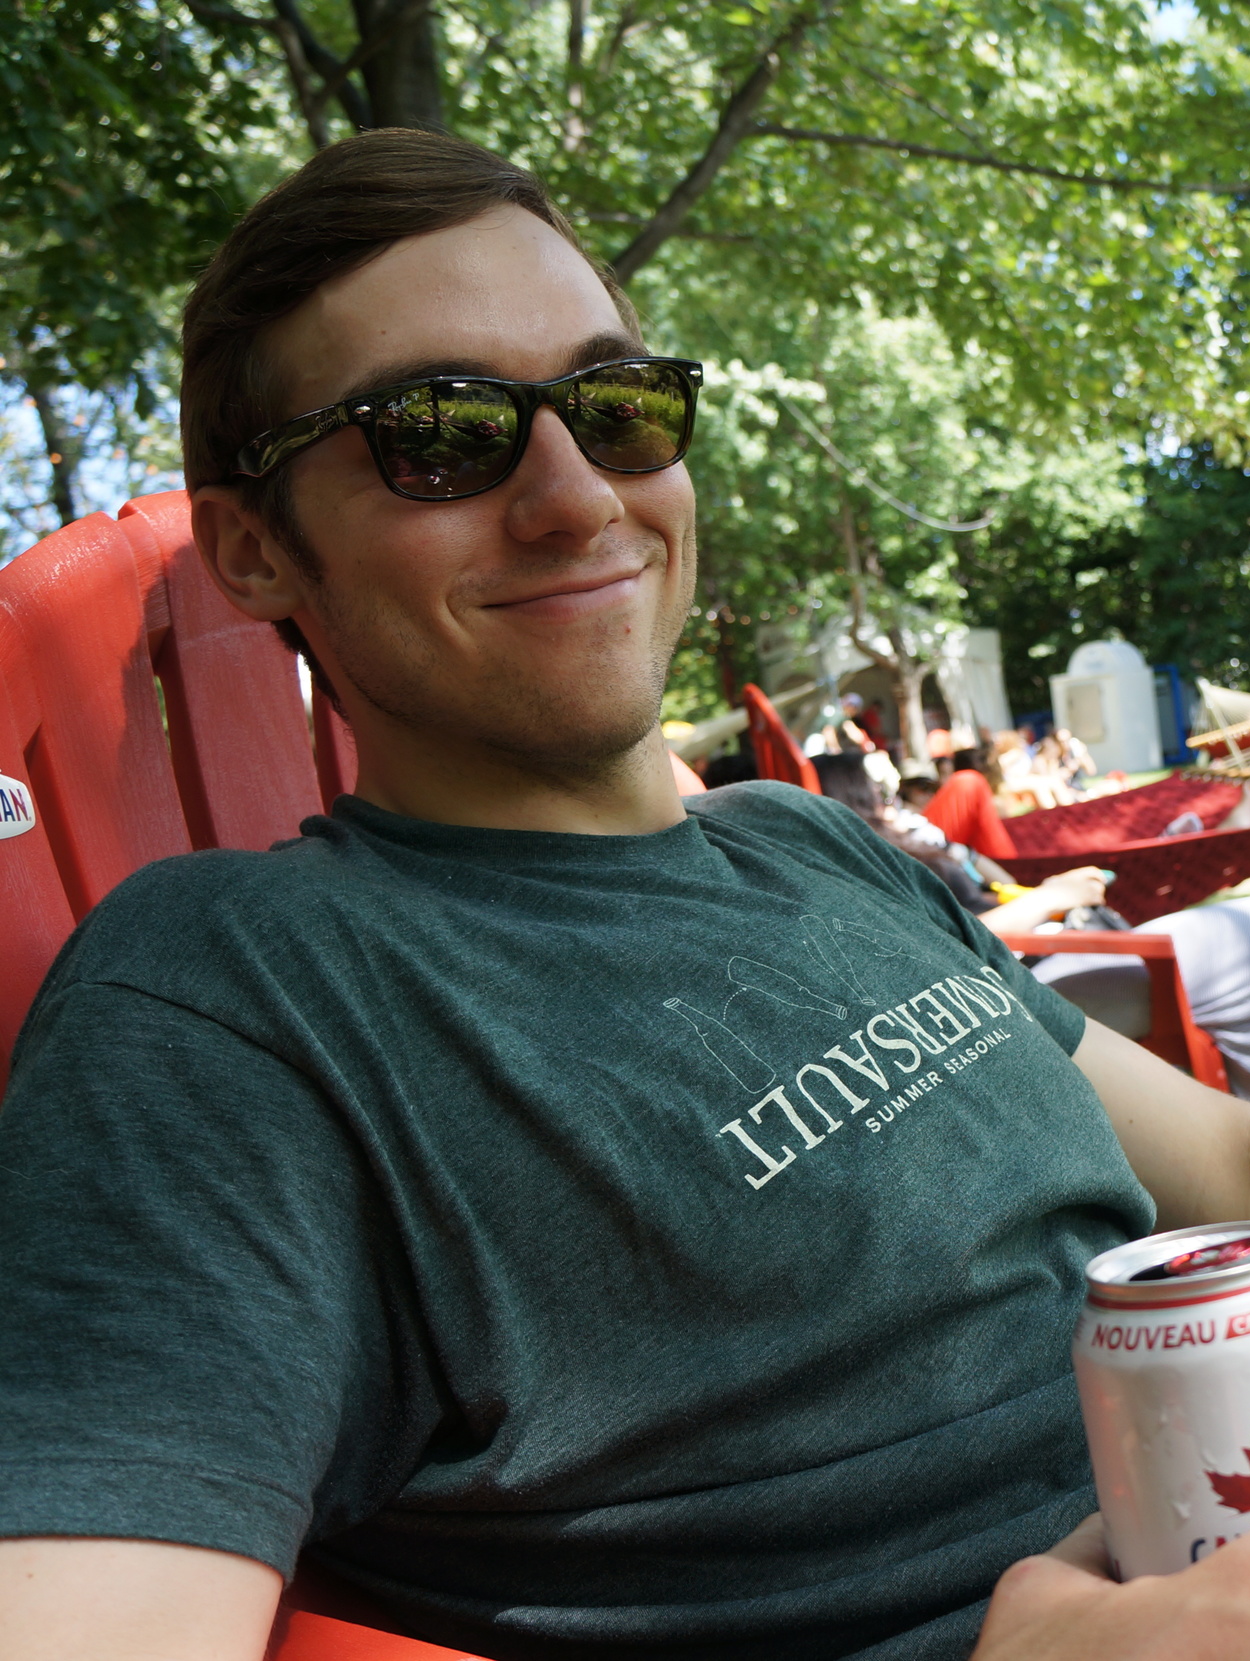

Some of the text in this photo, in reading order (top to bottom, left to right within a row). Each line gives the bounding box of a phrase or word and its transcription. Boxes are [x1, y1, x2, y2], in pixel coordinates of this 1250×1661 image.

[0, 788, 29, 822] AN
[865, 1028, 1011, 1133] SUMMER SEASONAL
[1091, 1320, 1216, 1350] NOUVEAU
